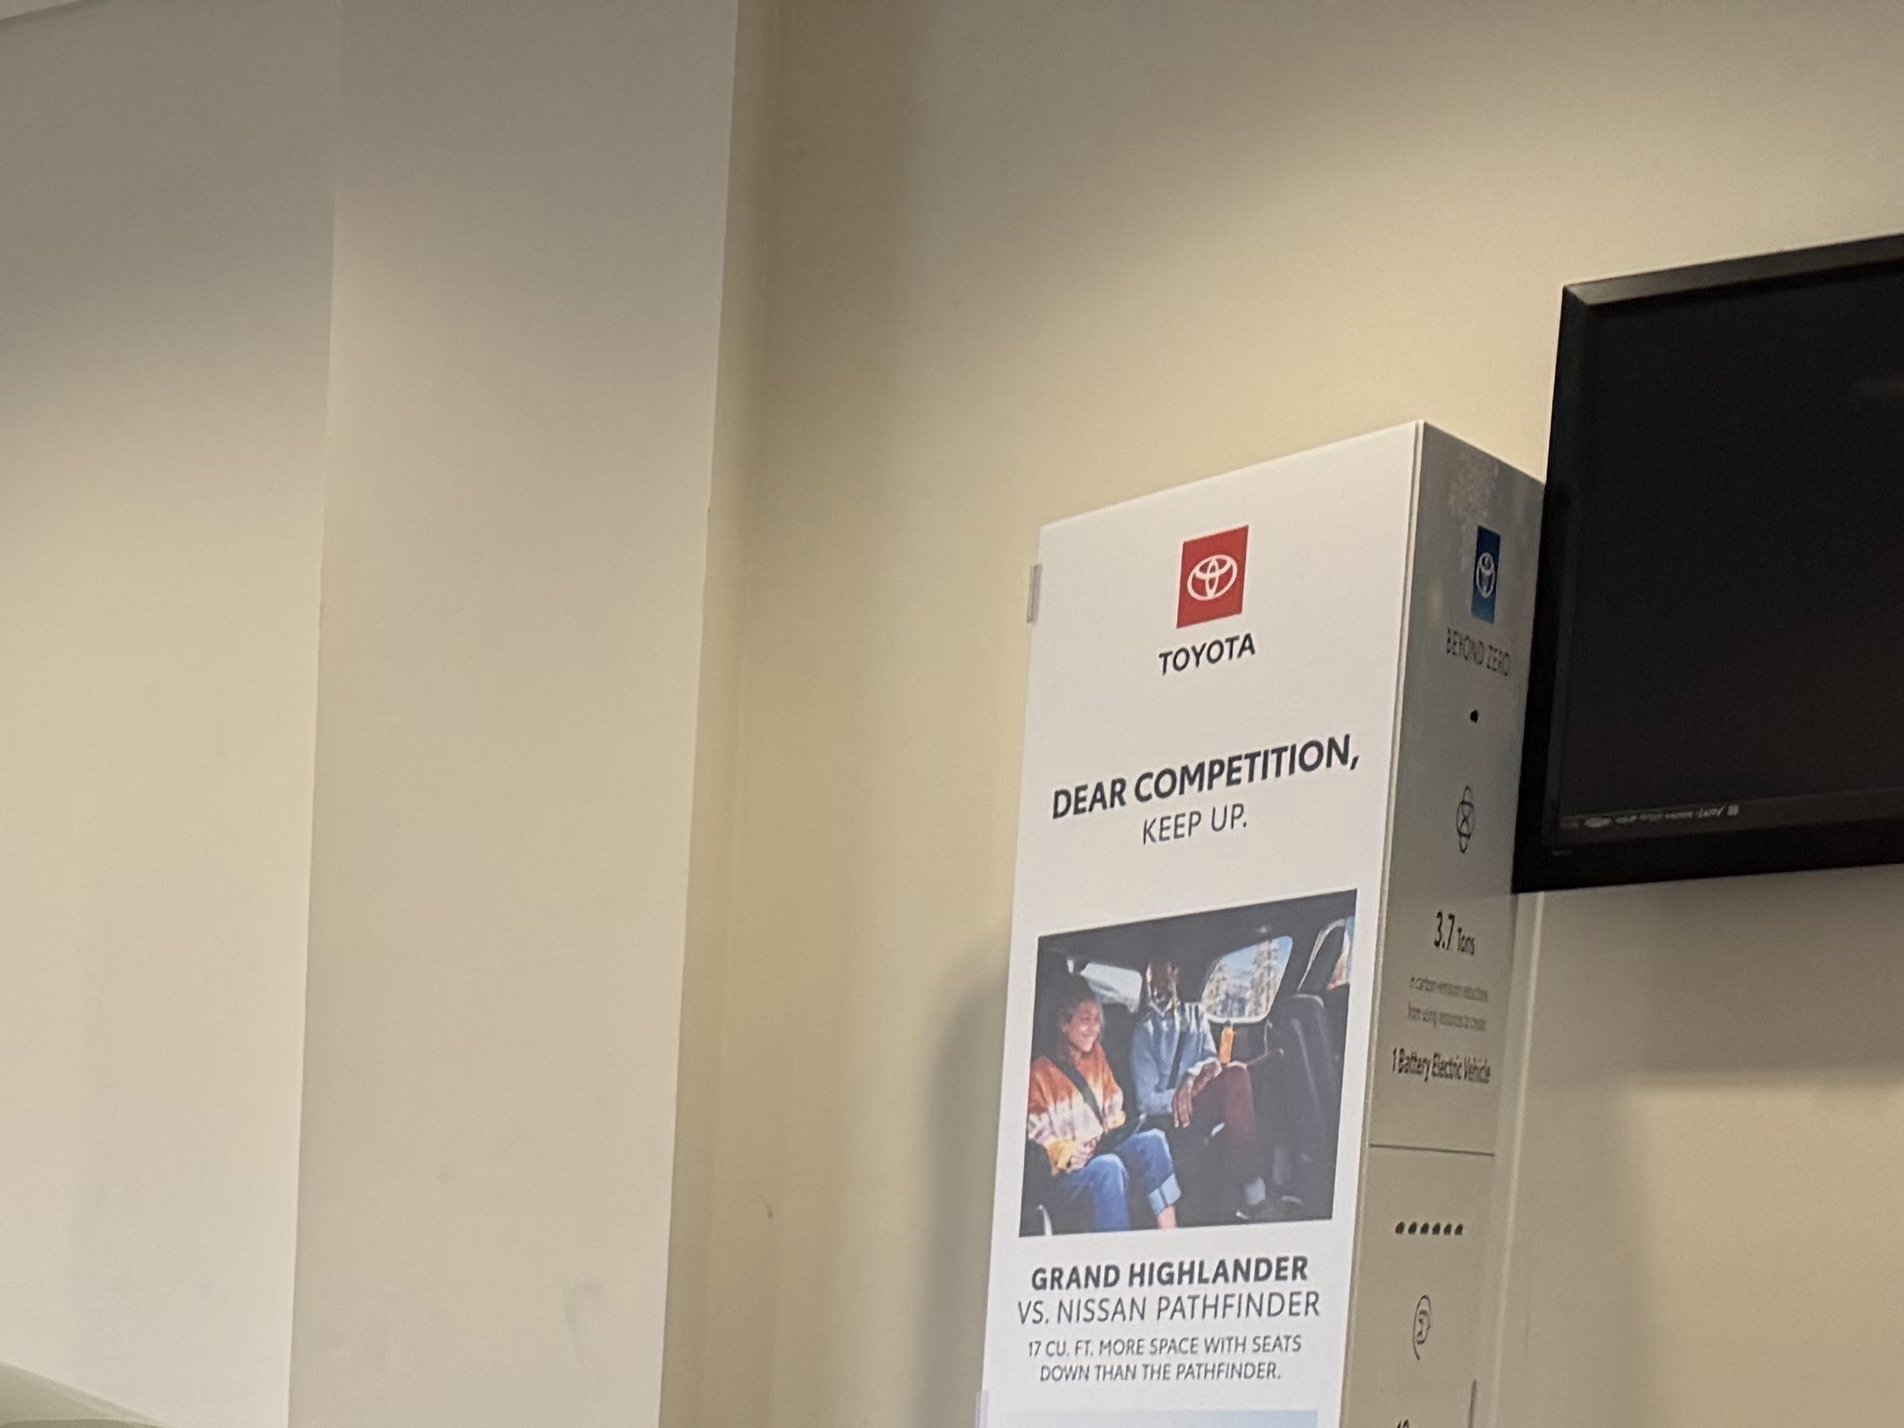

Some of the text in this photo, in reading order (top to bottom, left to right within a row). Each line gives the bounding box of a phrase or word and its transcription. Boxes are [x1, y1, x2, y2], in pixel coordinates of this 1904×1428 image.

[1158, 632, 1256, 676] TOYOTA
[1052, 733, 1360, 820] DEAR COMPETITION,
[1143, 803, 1247, 845] KEEP UP.
[1433, 910, 1476, 957] 3.7 Tons
[1392, 1047, 1491, 1084] 1 Battery Electric Vehicle
[1031, 1255, 1308, 1290] GRAND HIGHLANDER
[1017, 1290, 1321, 1325] VS. NISSAN PATHFINDER
[1028, 1334, 1302, 1359] 17 CU. FT. MORE SPACE WITH SEATS
[1040, 1360, 1282, 1383] DOWN THAN THE PATHFINDER.
